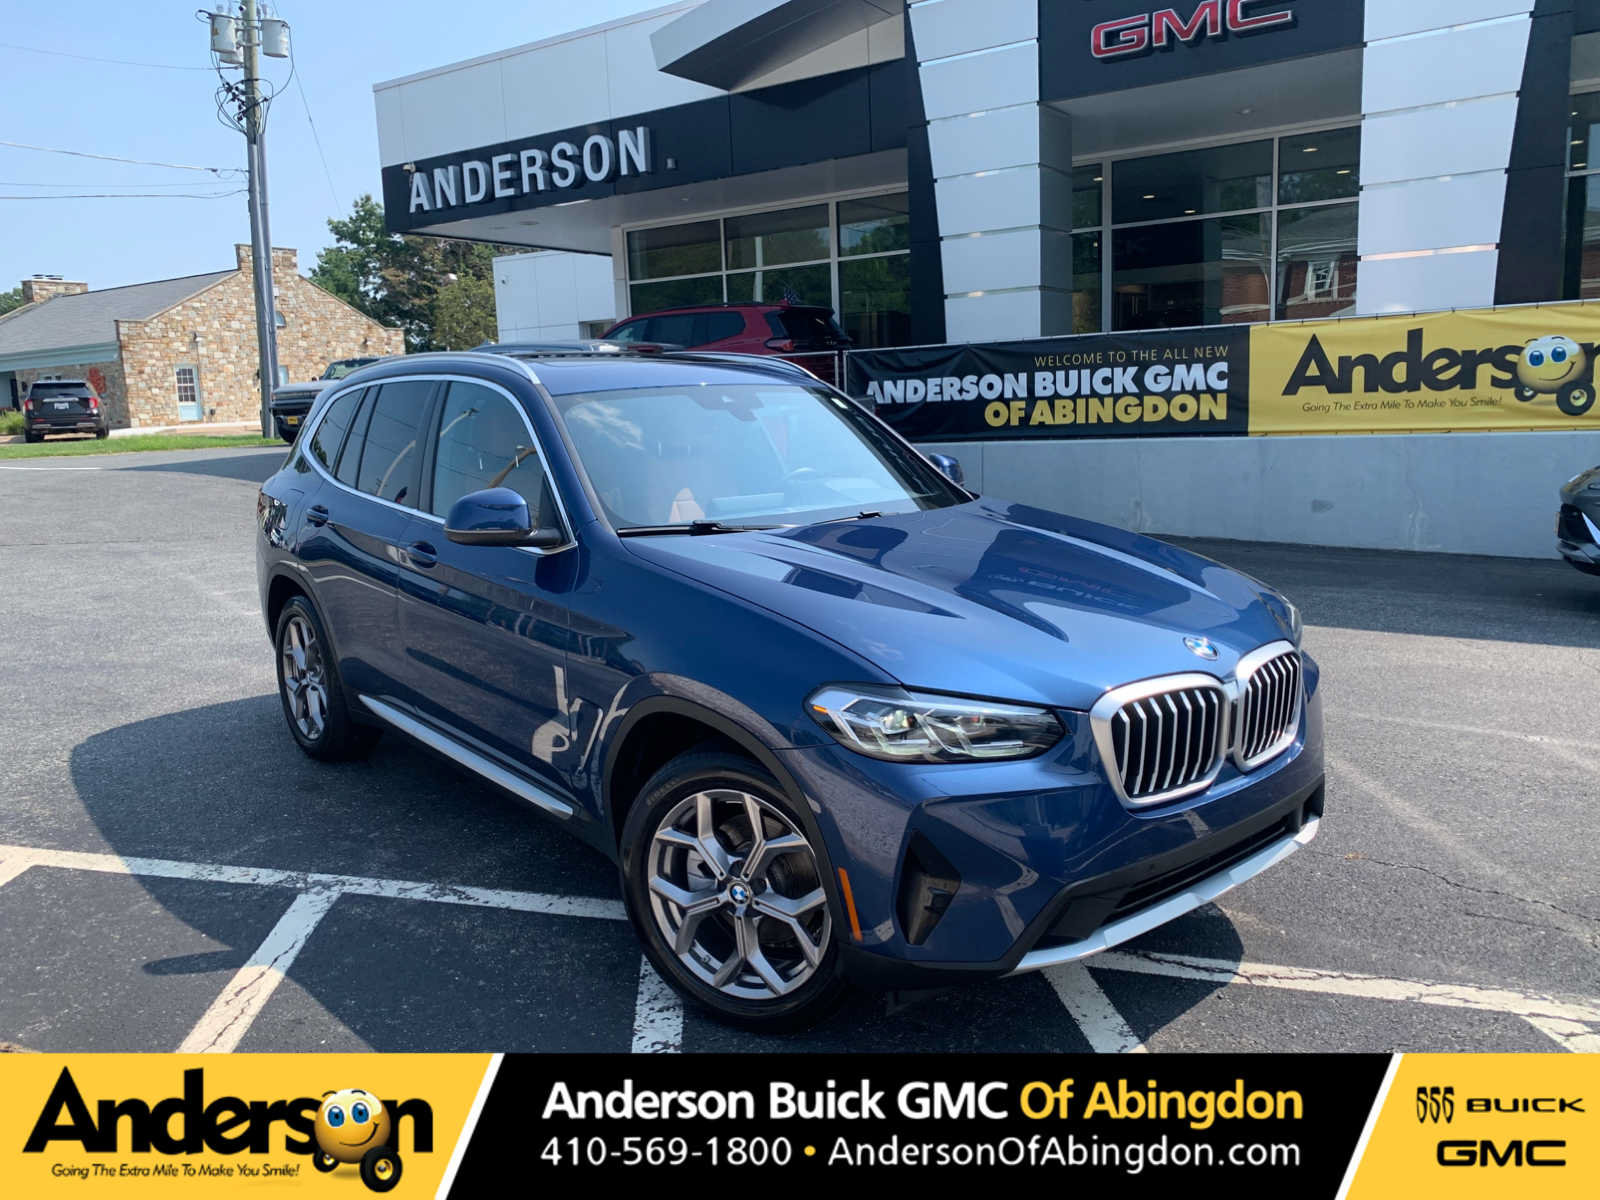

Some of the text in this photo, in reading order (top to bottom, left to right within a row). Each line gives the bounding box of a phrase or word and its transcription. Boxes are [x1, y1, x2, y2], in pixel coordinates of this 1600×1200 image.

[1091, 0, 1292, 58] GMC
[409, 126, 649, 213] ANDERSON
[1034, 345, 1229, 367] WELCOME TO THE ALL NEW
[867, 361, 1229, 404] ANDERSON BUICK GMC
[984, 393, 1228, 427] OF ABINGDON
[1302, 402, 1331, 413] Going
[1333, 401, 1352, 411] The
[1353, 401, 1378, 411] Extra
[1380, 399, 1401, 410] Mile
[1404, 399, 1415, 409] To
[1417, 398, 1448, 409] Make
[1449, 397, 1468, 408] You
